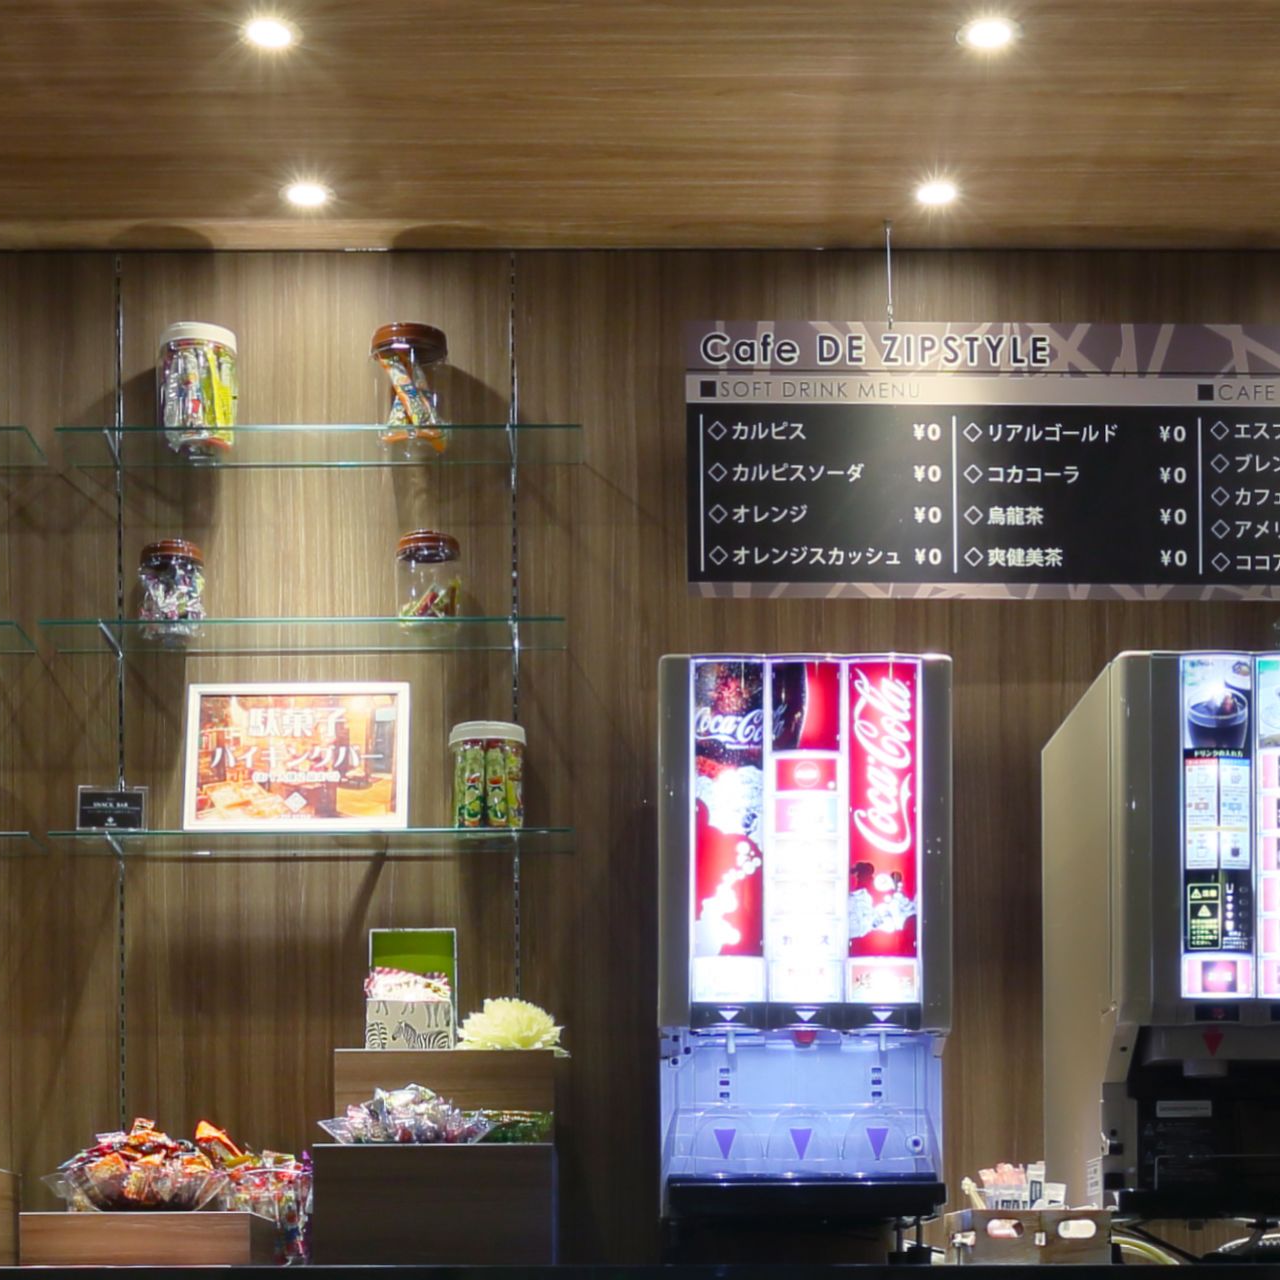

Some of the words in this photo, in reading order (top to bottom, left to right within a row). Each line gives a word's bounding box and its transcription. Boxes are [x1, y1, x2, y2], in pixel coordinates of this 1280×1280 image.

[700, 332, 799, 365] Cafe
[817, 334, 865, 365] DE
[881, 334, 1050, 367] ZIPSTYLE
[721, 381, 772, 398] SOFT
[782, 381, 848, 398] DRINK
[859, 382, 920, 398] MENU
[1218, 384, 1275, 401] CAFE
[732, 423, 807, 441] カルピス
[913, 424, 941, 441] ¥0
[988, 424, 1118, 443] リアルゴールド
[1160, 426, 1186, 442] ¥0
[733, 464, 864, 482] カルピスソーダ
[914, 466, 942, 483] ¥0
[988, 466, 1080, 484] コカコーラ
[1160, 467, 1186, 484] ¥0
[733, 505, 808, 524] オレンジ
[914, 507, 942, 524] ¥0
[1161, 509, 1187, 526] ¥0
[733, 547, 901, 566] オレンジスカッシュ
[915, 549, 942, 566] ¥0
[987, 547, 1063, 567] 爽健美茶
[1161, 550, 1187, 567] ¥0
[248, 707, 347, 737] 駄菓子
[211, 745, 384, 768] バイキングバー
[854, 668, 912, 854] Coca-Cola
